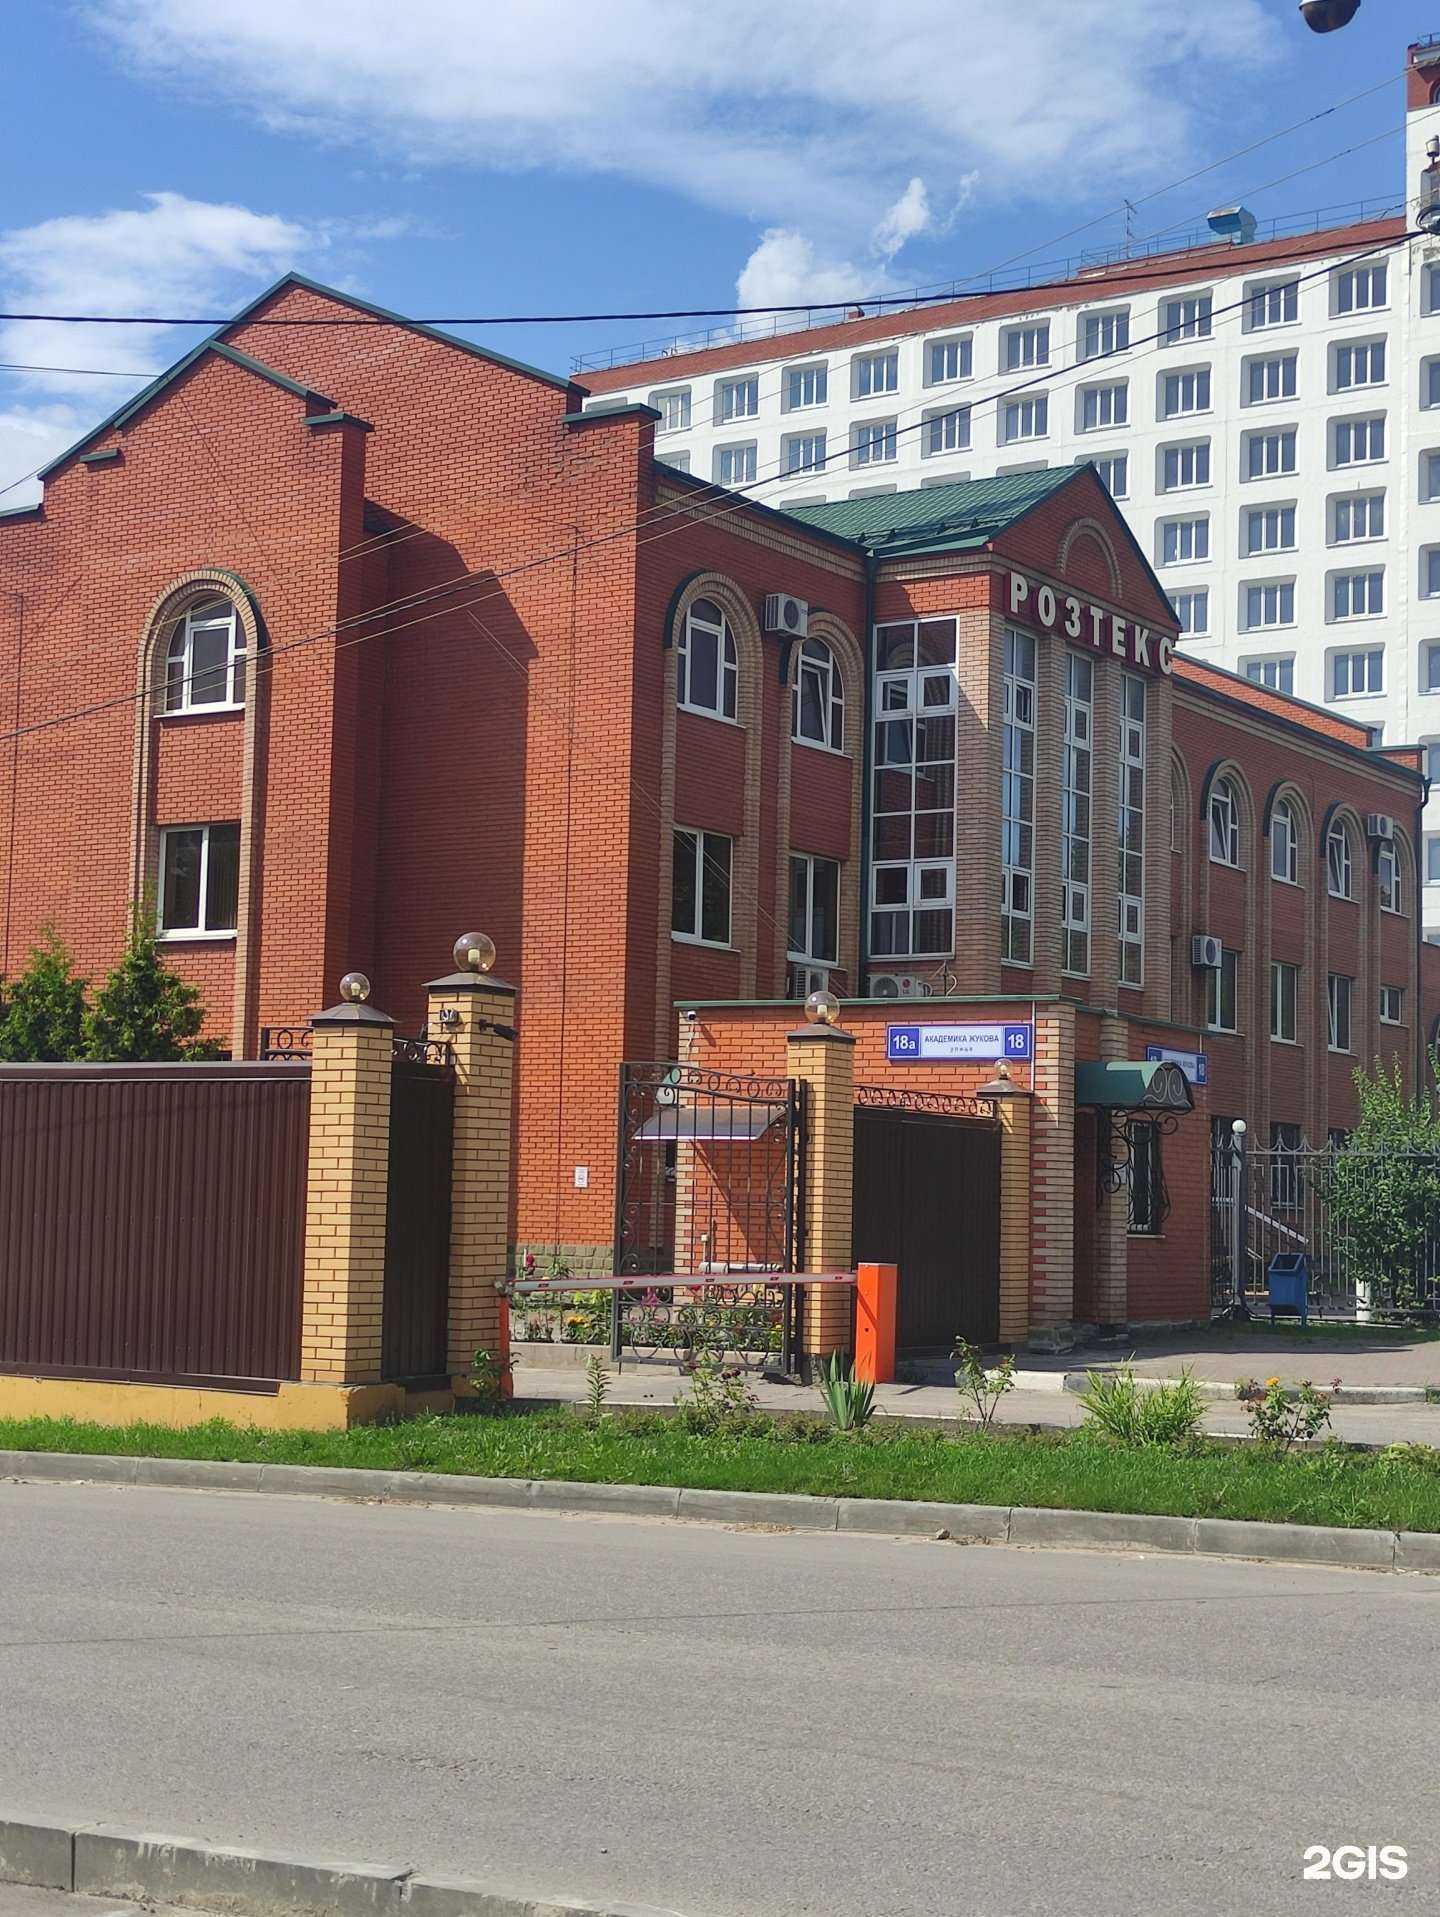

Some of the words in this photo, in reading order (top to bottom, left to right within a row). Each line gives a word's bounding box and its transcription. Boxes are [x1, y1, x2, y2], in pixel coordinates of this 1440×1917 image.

[1010, 571, 1173, 675] РОЗТЕКС
[893, 1035, 916, 1050] 18а
[924, 1034, 967, 1043] АКАДЕМИКА
[969, 1034, 999, 1043] ЖУКОВА
[1008, 1034, 1024, 1049] 18
